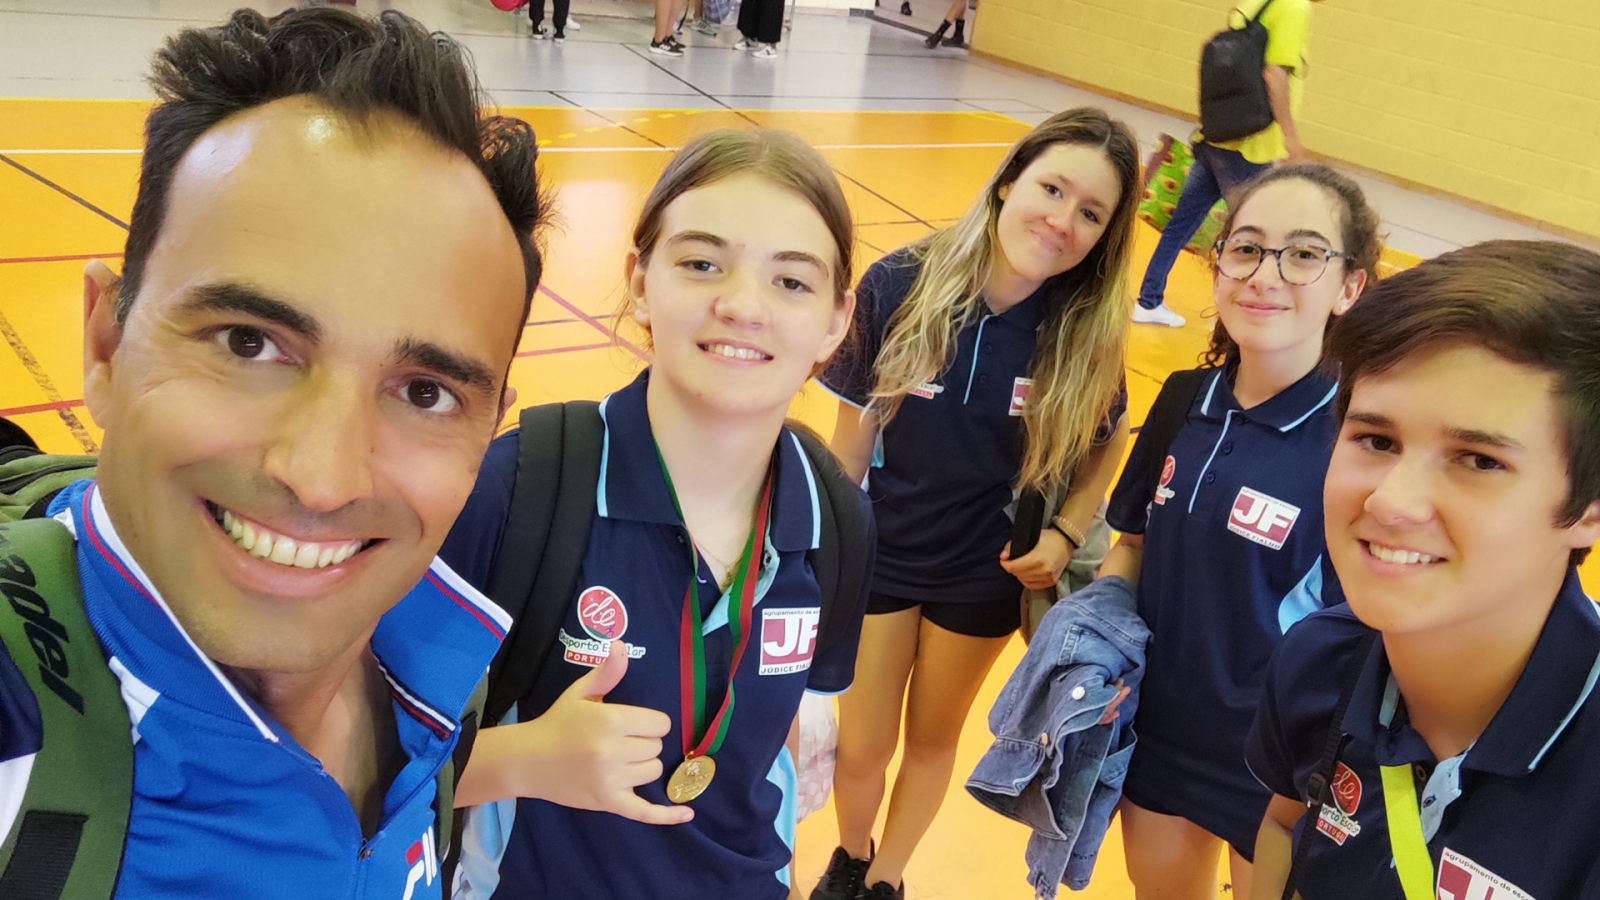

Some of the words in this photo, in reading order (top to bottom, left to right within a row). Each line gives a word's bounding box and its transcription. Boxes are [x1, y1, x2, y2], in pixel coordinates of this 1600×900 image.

[1233, 496, 1297, 533] JF
[763, 617, 819, 657] JF
[567, 651, 606, 664] PORTU
[1445, 851, 1499, 885] agrupamento
[1500, 882, 1511, 891] de
